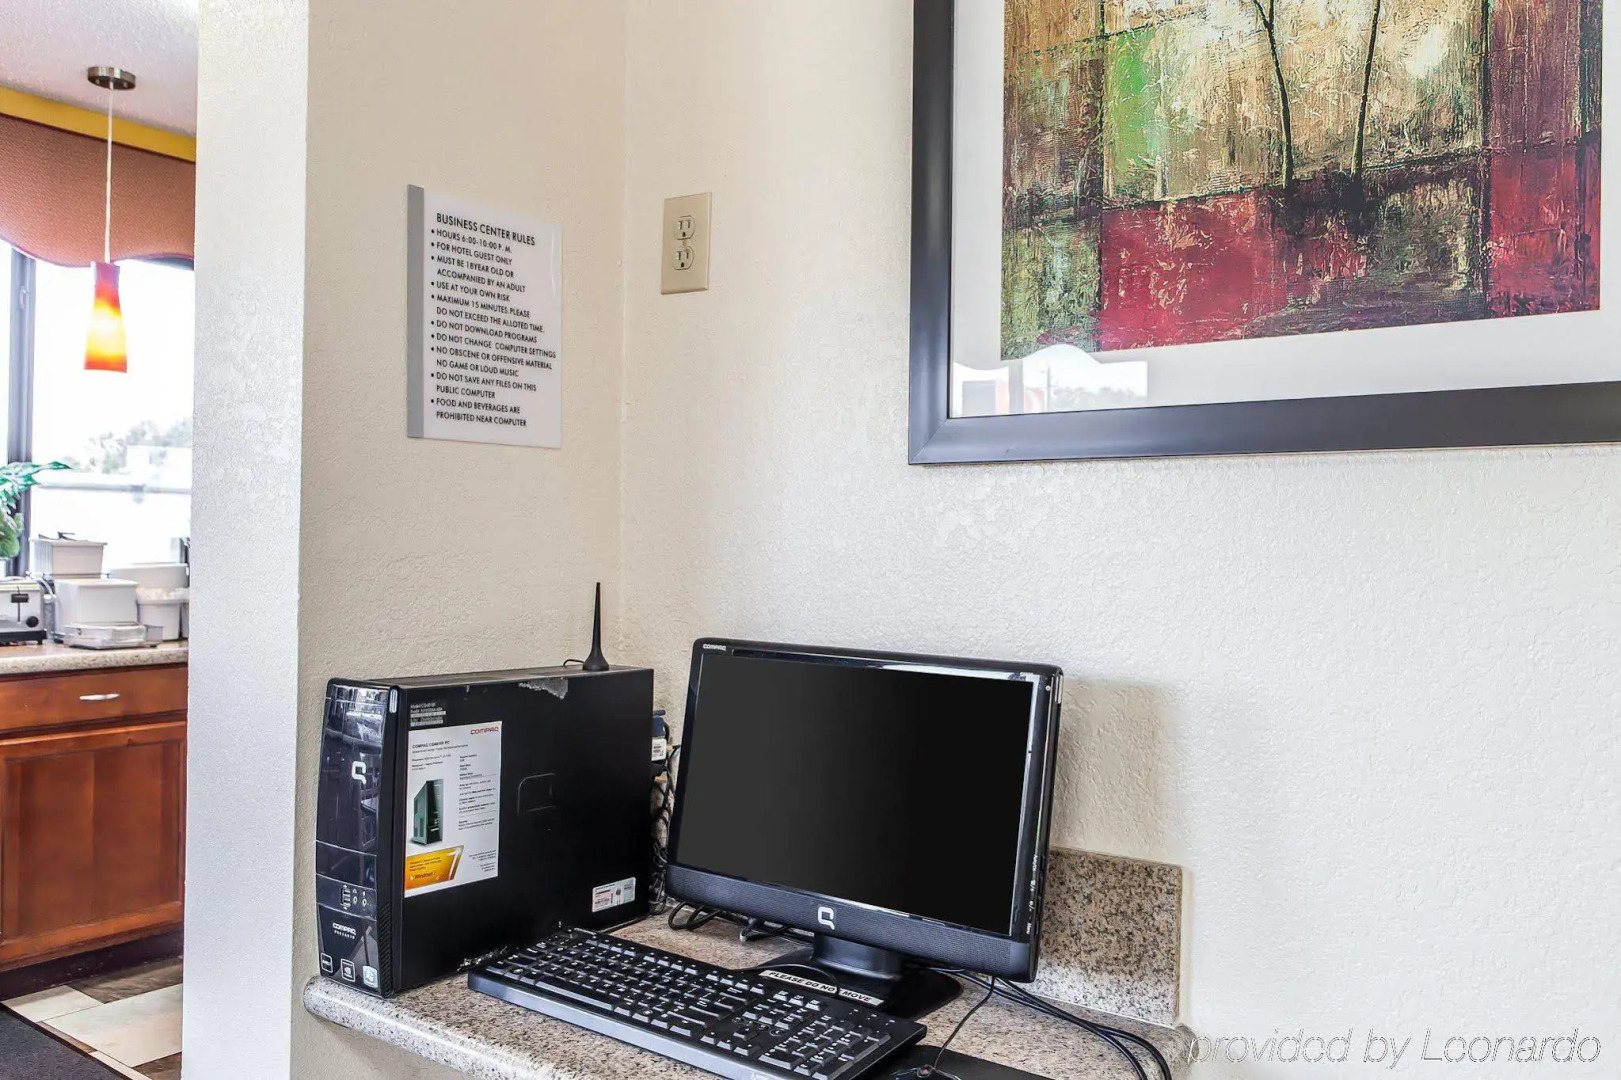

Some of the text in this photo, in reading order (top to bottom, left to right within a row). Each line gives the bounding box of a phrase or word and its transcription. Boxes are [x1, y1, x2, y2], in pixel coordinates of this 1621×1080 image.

[437, 213, 535, 246] BUSINESS CENTER RULES
[437, 229, 460, 241] HOURS
[437, 242, 512, 266] FOR HOTEL GUEST ONLY
[437, 255, 455, 265] MUST
[457, 259, 464, 267] BE
[491, 267, 503, 276] OLD
[437, 269, 525, 293] ACCOMPANIED BY AN ADULT
[437, 281, 449, 290] USE
[460, 286, 478, 296] YOUR
[480, 289, 496, 299] OWN
[497, 293, 510, 301] RISK
[437, 294, 469, 306] MAXIMUM
[472, 300, 479, 308] 15
[510, 308, 530, 318] PLEASE
[437, 307, 447, 315] DO
[449, 308, 463, 318] NOT
[465, 311, 488, 322] EXCEED
[490, 317, 501, 325] THE
[502, 319, 528, 330] ALLOTED
[437, 320, 537, 343] DO NOT DOWNLOAD PROGRAMS
[449, 335, 463, 344] NOT
[465, 338, 492, 349] CHANGE
[495, 342, 528, 354] COMPUTER
[529, 348, 556, 358] SETTINGS
[450, 348, 480, 359] OBSCENE
[481, 352, 490, 361] OR
[492, 354, 524, 366] OFFENSIVE
[525, 359, 552, 370] MATERIAL
[450, 361, 468, 371] GAME
[481, 366, 498, 374] LOUD
[500, 368, 519, 377] MUSIC
[437, 385, 495, 398] PUBLIC COMPUTER
[449, 374, 463, 382] NOT
[465, 376, 480, 384] SAVE
[481, 378, 494, 386] ANY
[496, 380, 511, 388] FILES
[437, 398, 456, 407] FOOD
[458, 400, 472, 409] AND
[474, 402, 508, 413] BEVERAGES
[437, 411, 526, 426] PROHIBITED NEAR COMPUTER
[332, 922, 356, 935] COMPAQ
[769, 971, 802, 983] PLEASE
[842, 991, 872, 1001] MOVE
